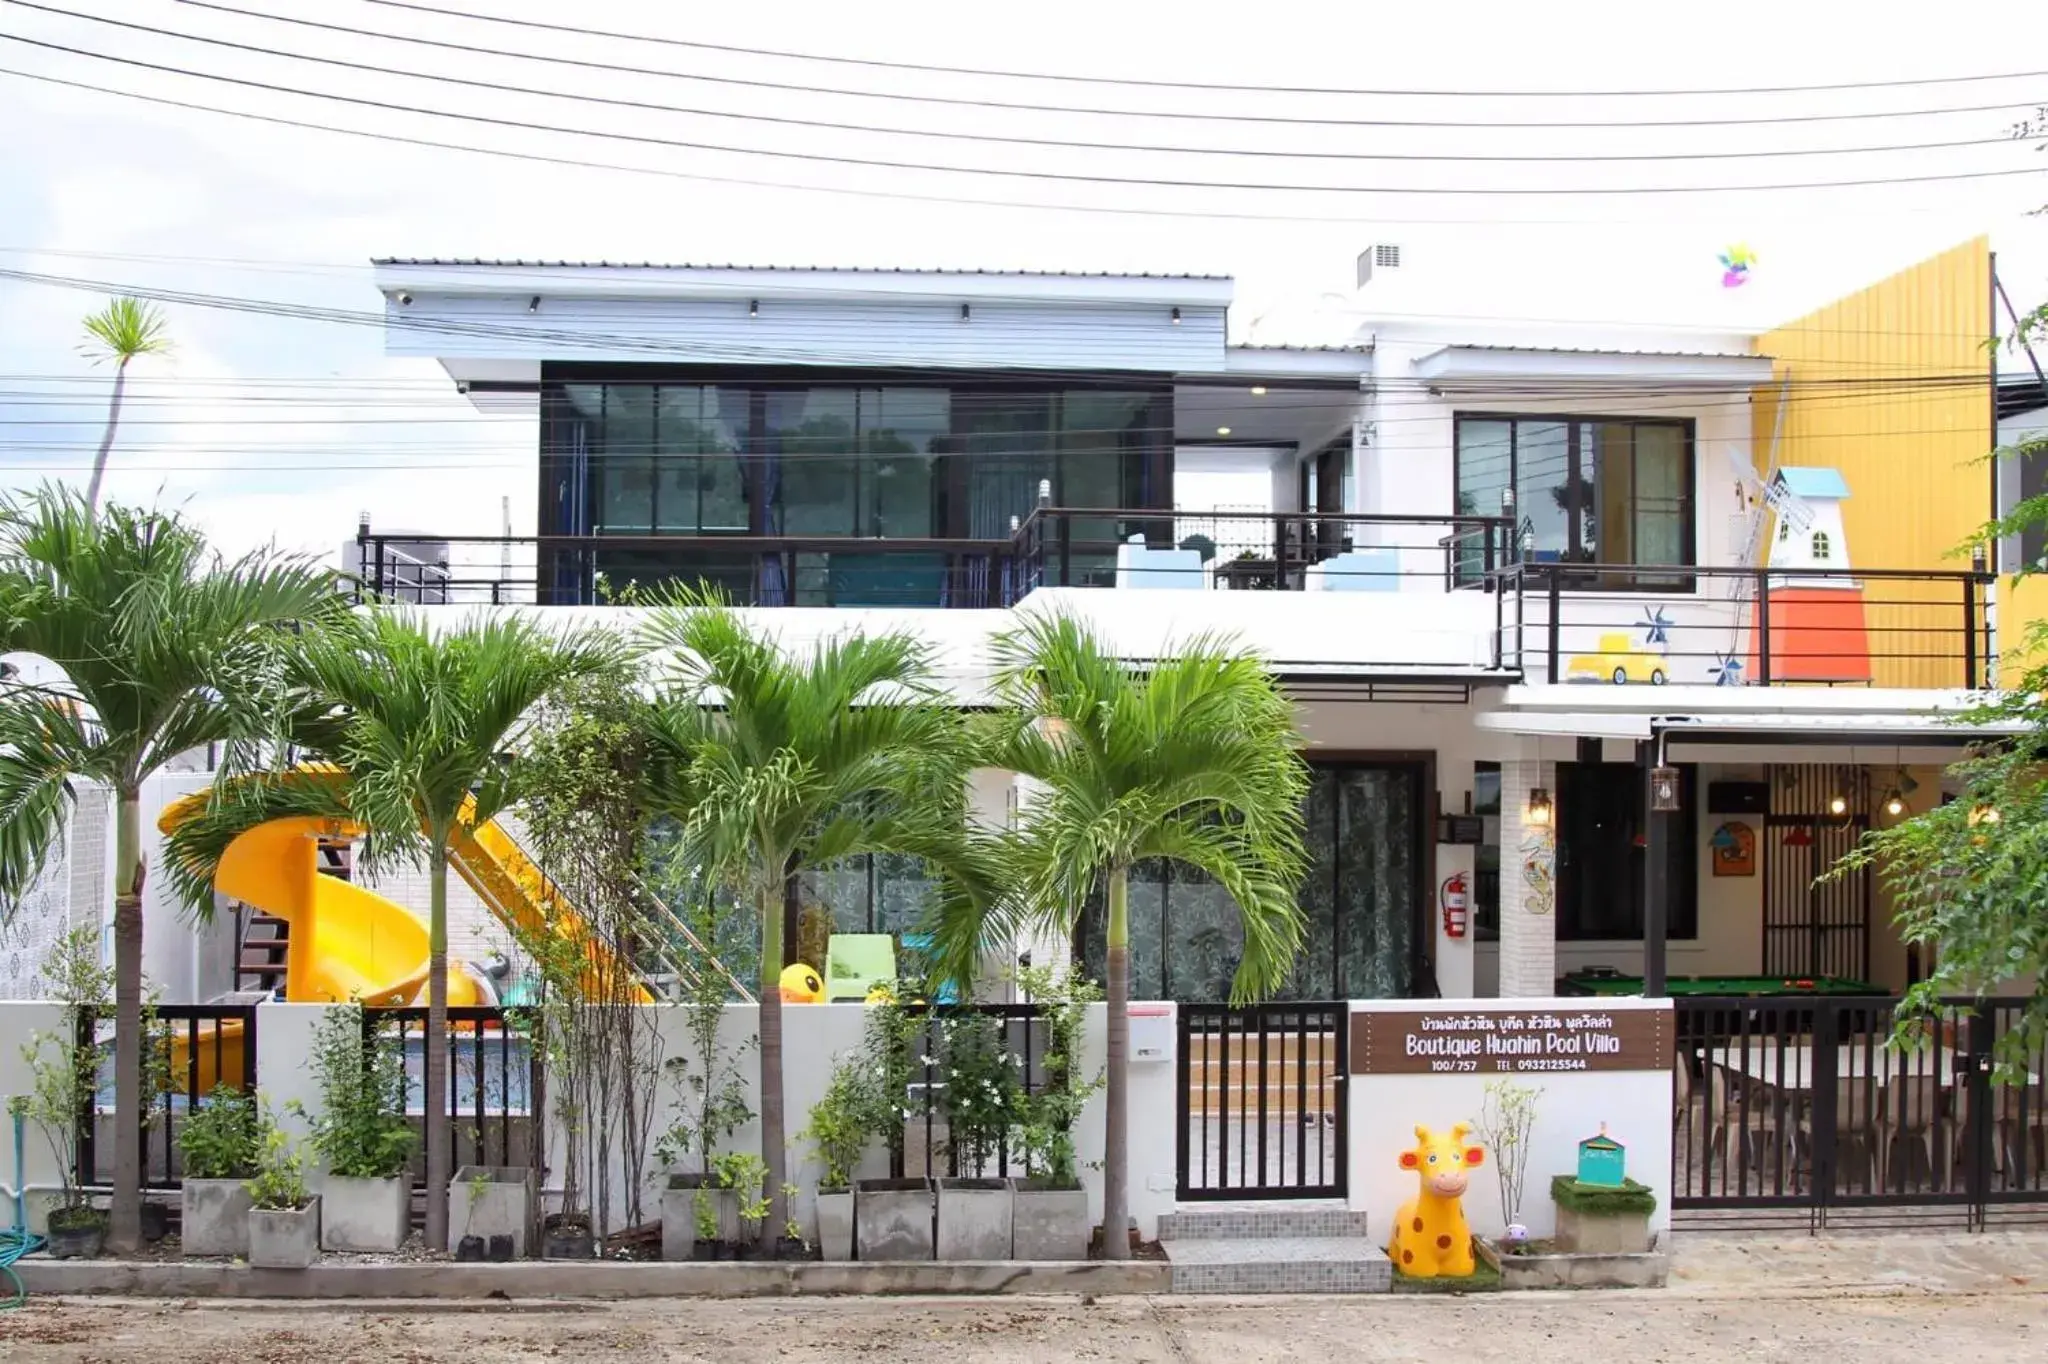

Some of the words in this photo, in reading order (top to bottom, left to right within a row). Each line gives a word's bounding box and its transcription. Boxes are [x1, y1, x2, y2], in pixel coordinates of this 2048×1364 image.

[1406, 1033, 1481, 1057] Boutique
[1486, 1033, 1541, 1055] Huahin
[1546, 1033, 1580, 1054] Pool
[1585, 1032, 1620, 1053] Villa
[1432, 1060, 1477, 1072] 100/757
[1518, 1059, 1586, 1071] 0932125544
